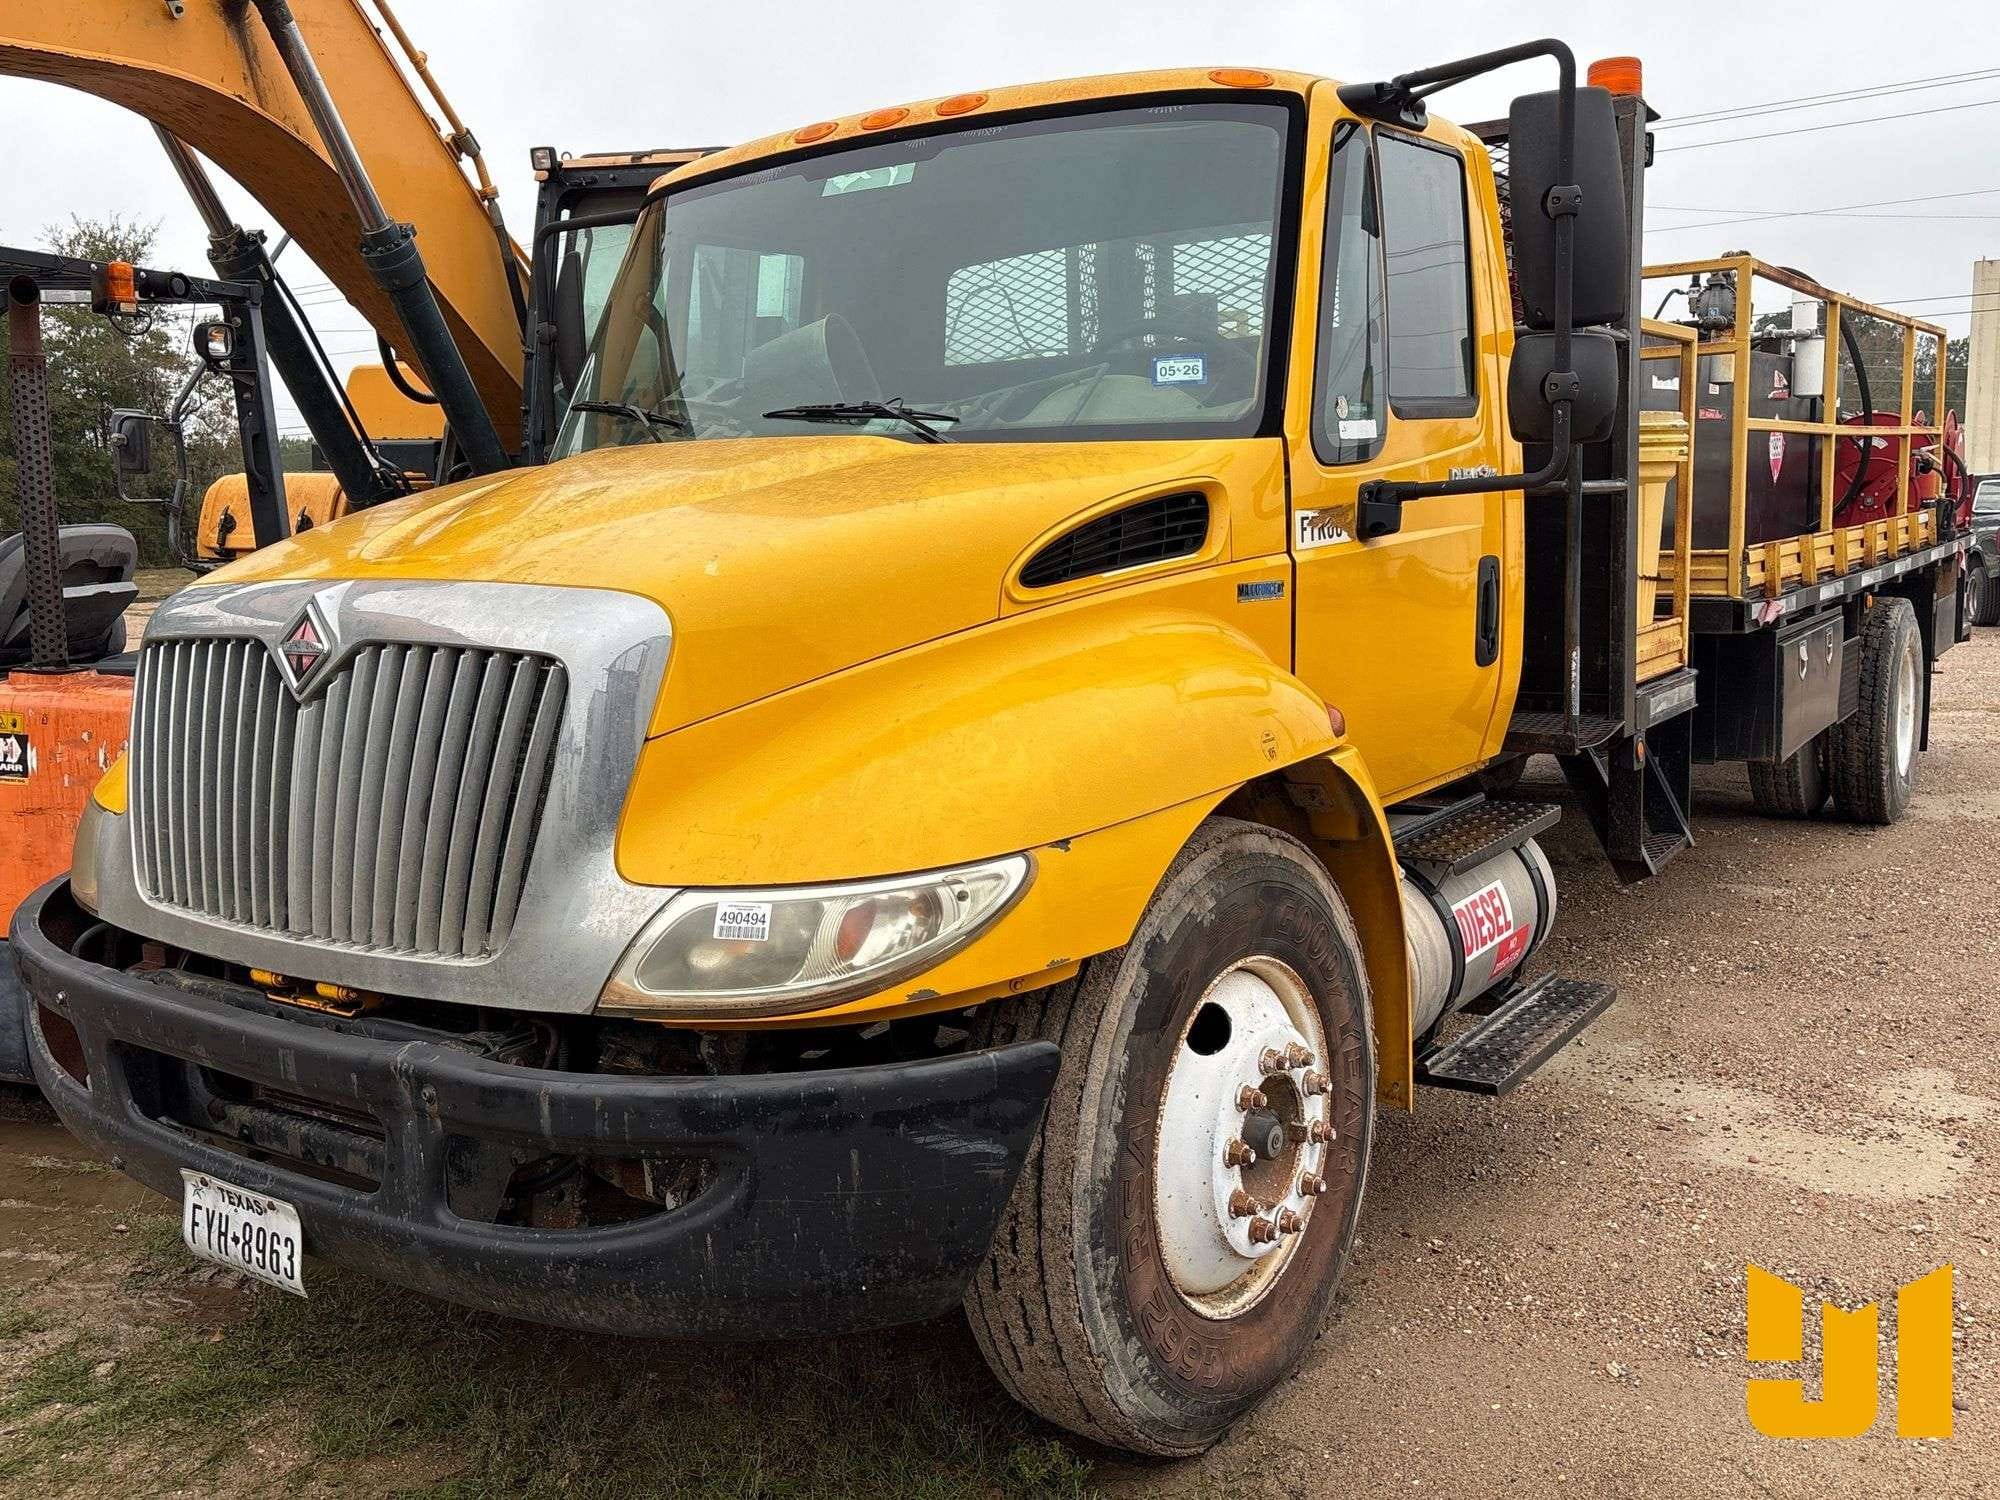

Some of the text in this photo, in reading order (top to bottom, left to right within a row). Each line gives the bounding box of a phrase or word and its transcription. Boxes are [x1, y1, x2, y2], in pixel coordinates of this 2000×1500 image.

[1159, 364, 1200, 377] 05 26
[719, 910, 767, 926] 490494
[1454, 886, 1512, 958] DIESEL
[216, 1185, 264, 1217] TEXAS
[1121, 1117, 1152, 1273] RSA
